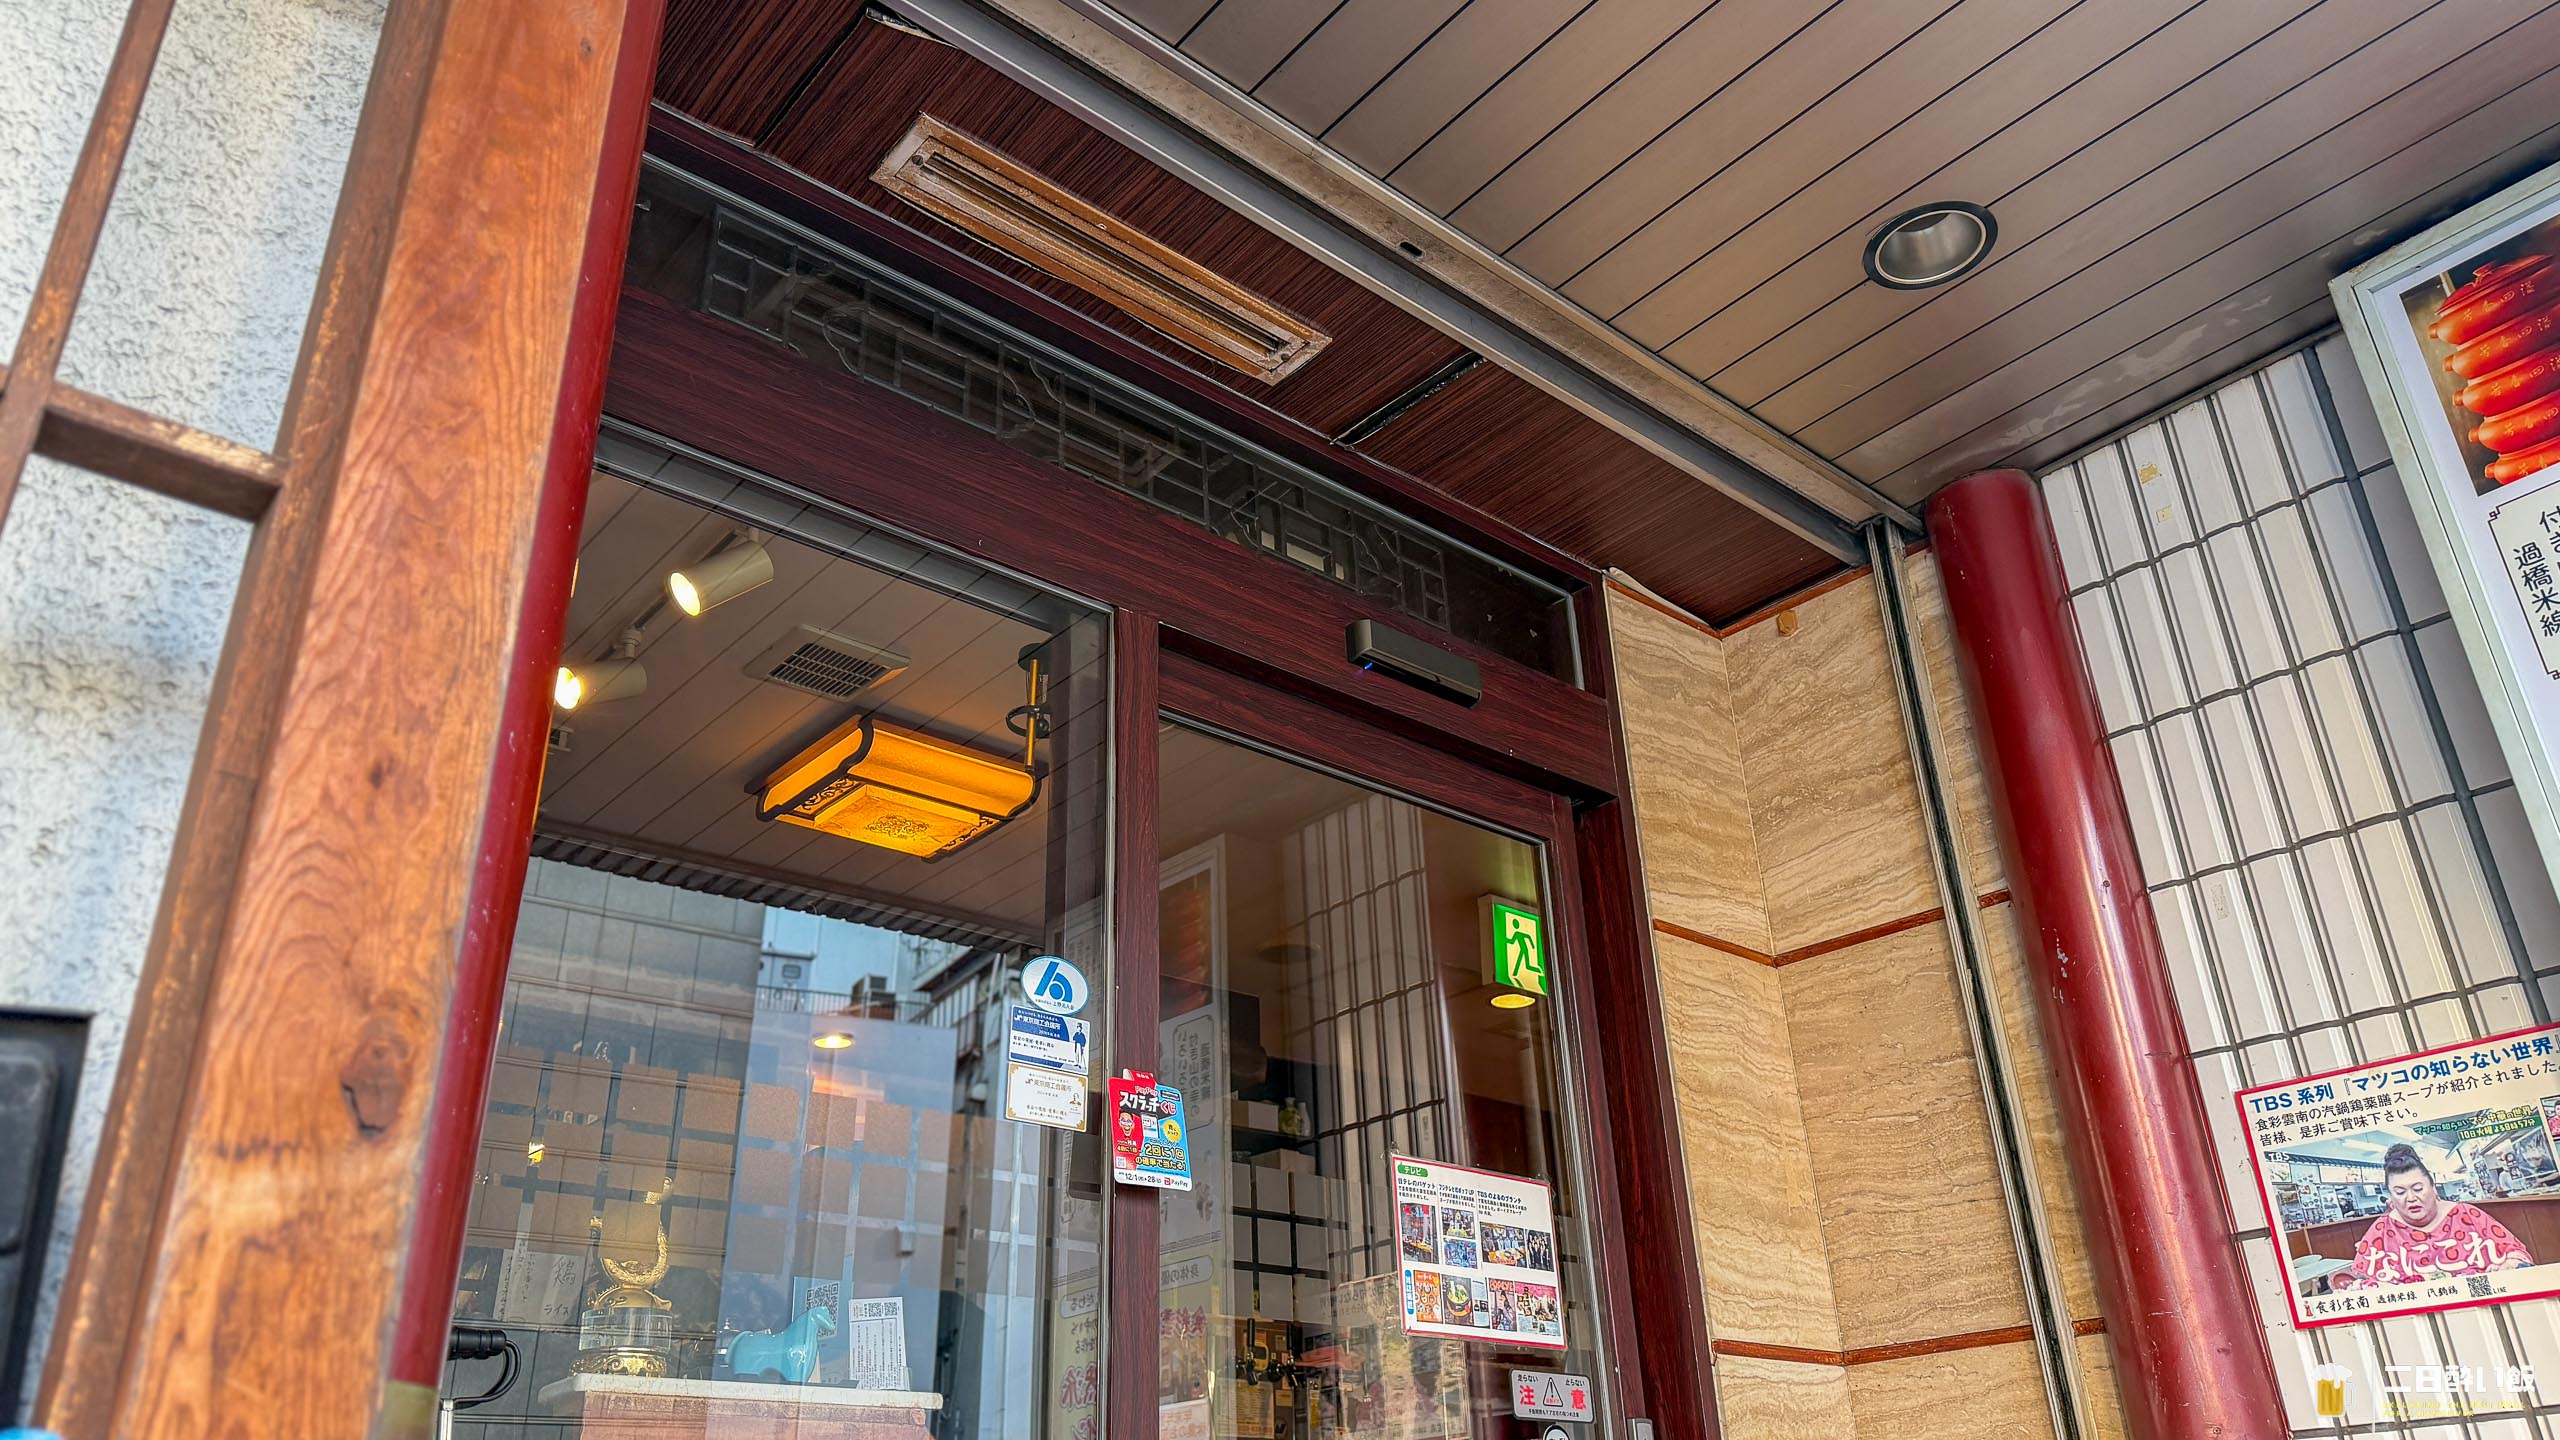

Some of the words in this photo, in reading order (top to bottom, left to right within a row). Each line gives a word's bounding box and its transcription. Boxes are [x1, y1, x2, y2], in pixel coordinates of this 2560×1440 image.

[2249, 1092, 2293, 1113] TBS
[2259, 1107, 2419, 1147] 皆様、是非ご賞味下さい。
[2267, 1151, 2290, 1161] TBS
[1403, 1166, 1422, 1175] テレビ
[2364, 1232, 2506, 1282] なにこれ
[2493, 1286, 2508, 1294] LINE
[1519, 1385, 1536, 1406] 注
[1570, 1388, 1587, 1410] 意
